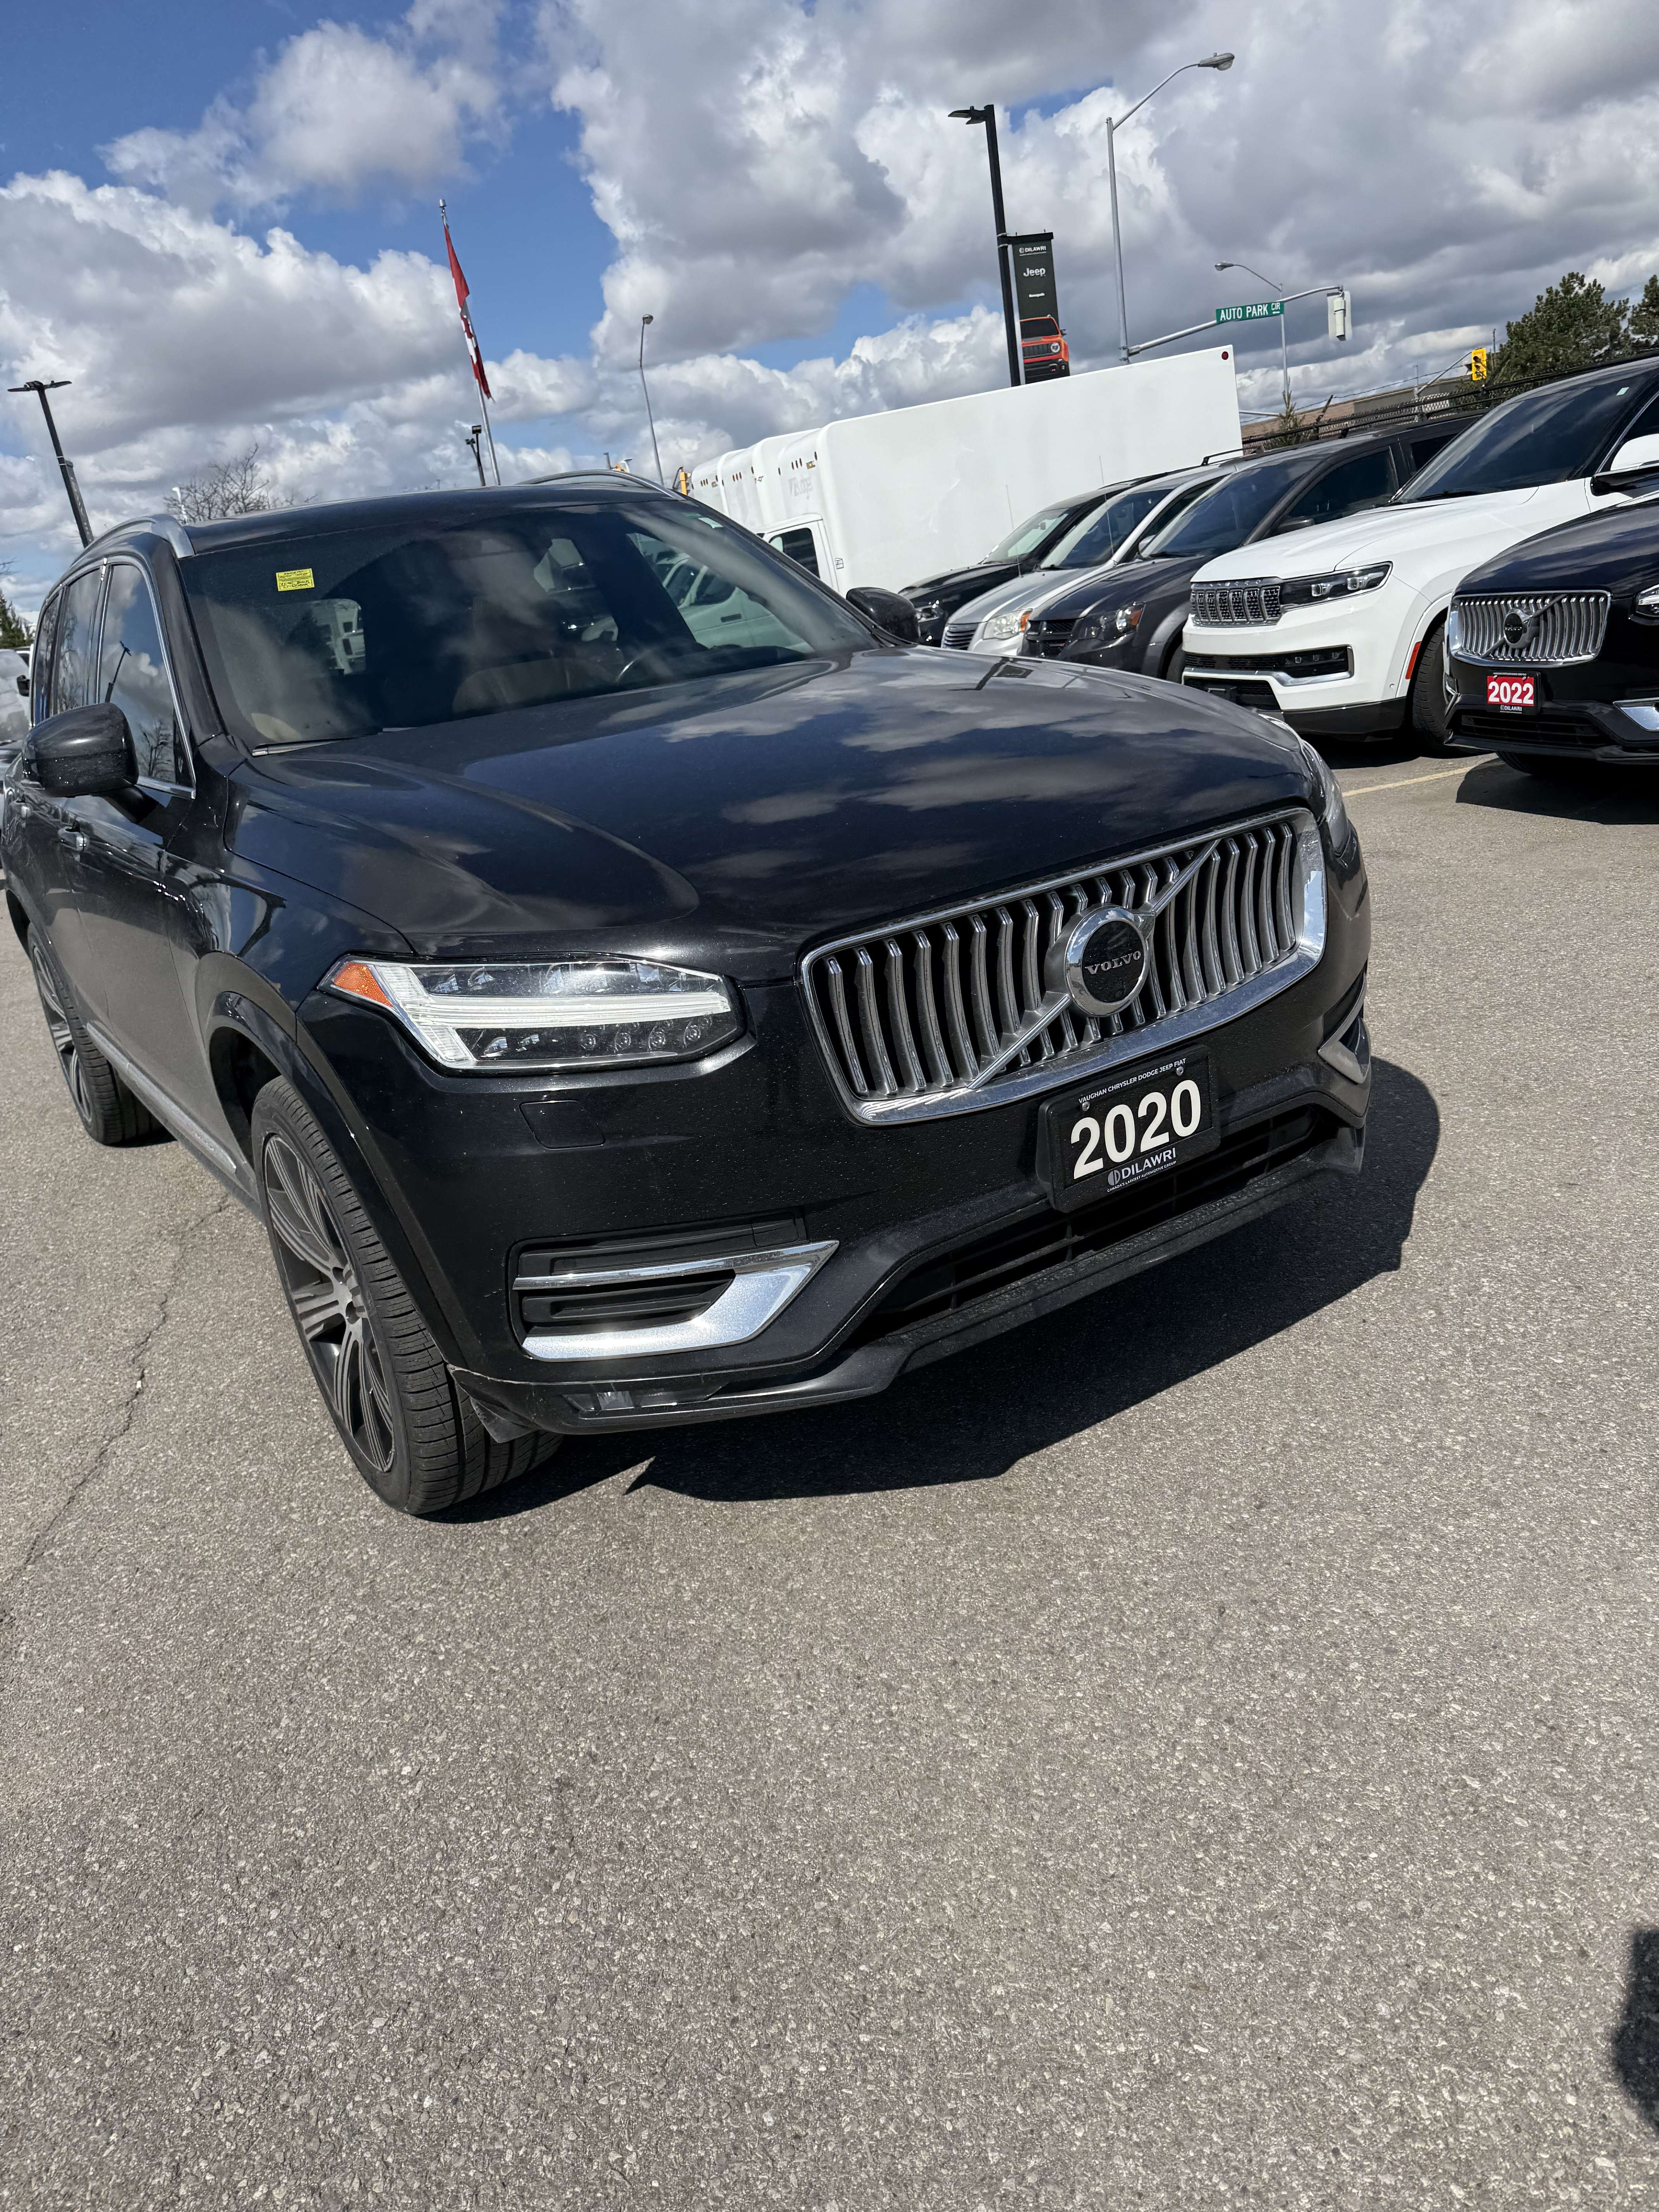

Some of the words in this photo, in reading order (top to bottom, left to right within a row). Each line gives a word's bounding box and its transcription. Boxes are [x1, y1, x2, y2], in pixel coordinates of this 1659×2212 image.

[1023, 268, 1046, 277] Jeep
[1220, 307, 1242, 321] AUTO
[1246, 304, 1268, 318] PARK
[1488, 681, 1534, 704] 2022
[1085, 951, 1141, 974] VOLVO
[1079, 1088, 1107, 1104] VAUGHAN
[1108, 1077, 1137, 1092] CHRYSLER
[1138, 1068, 1159, 1081] DODGE
[1159, 1063, 1173, 1073] JEEP
[1174, 1058, 1187, 1067] FIAT
[1070, 1080, 1201, 1179] 2020
[1121, 1147, 1176, 1179] DILAWRI
